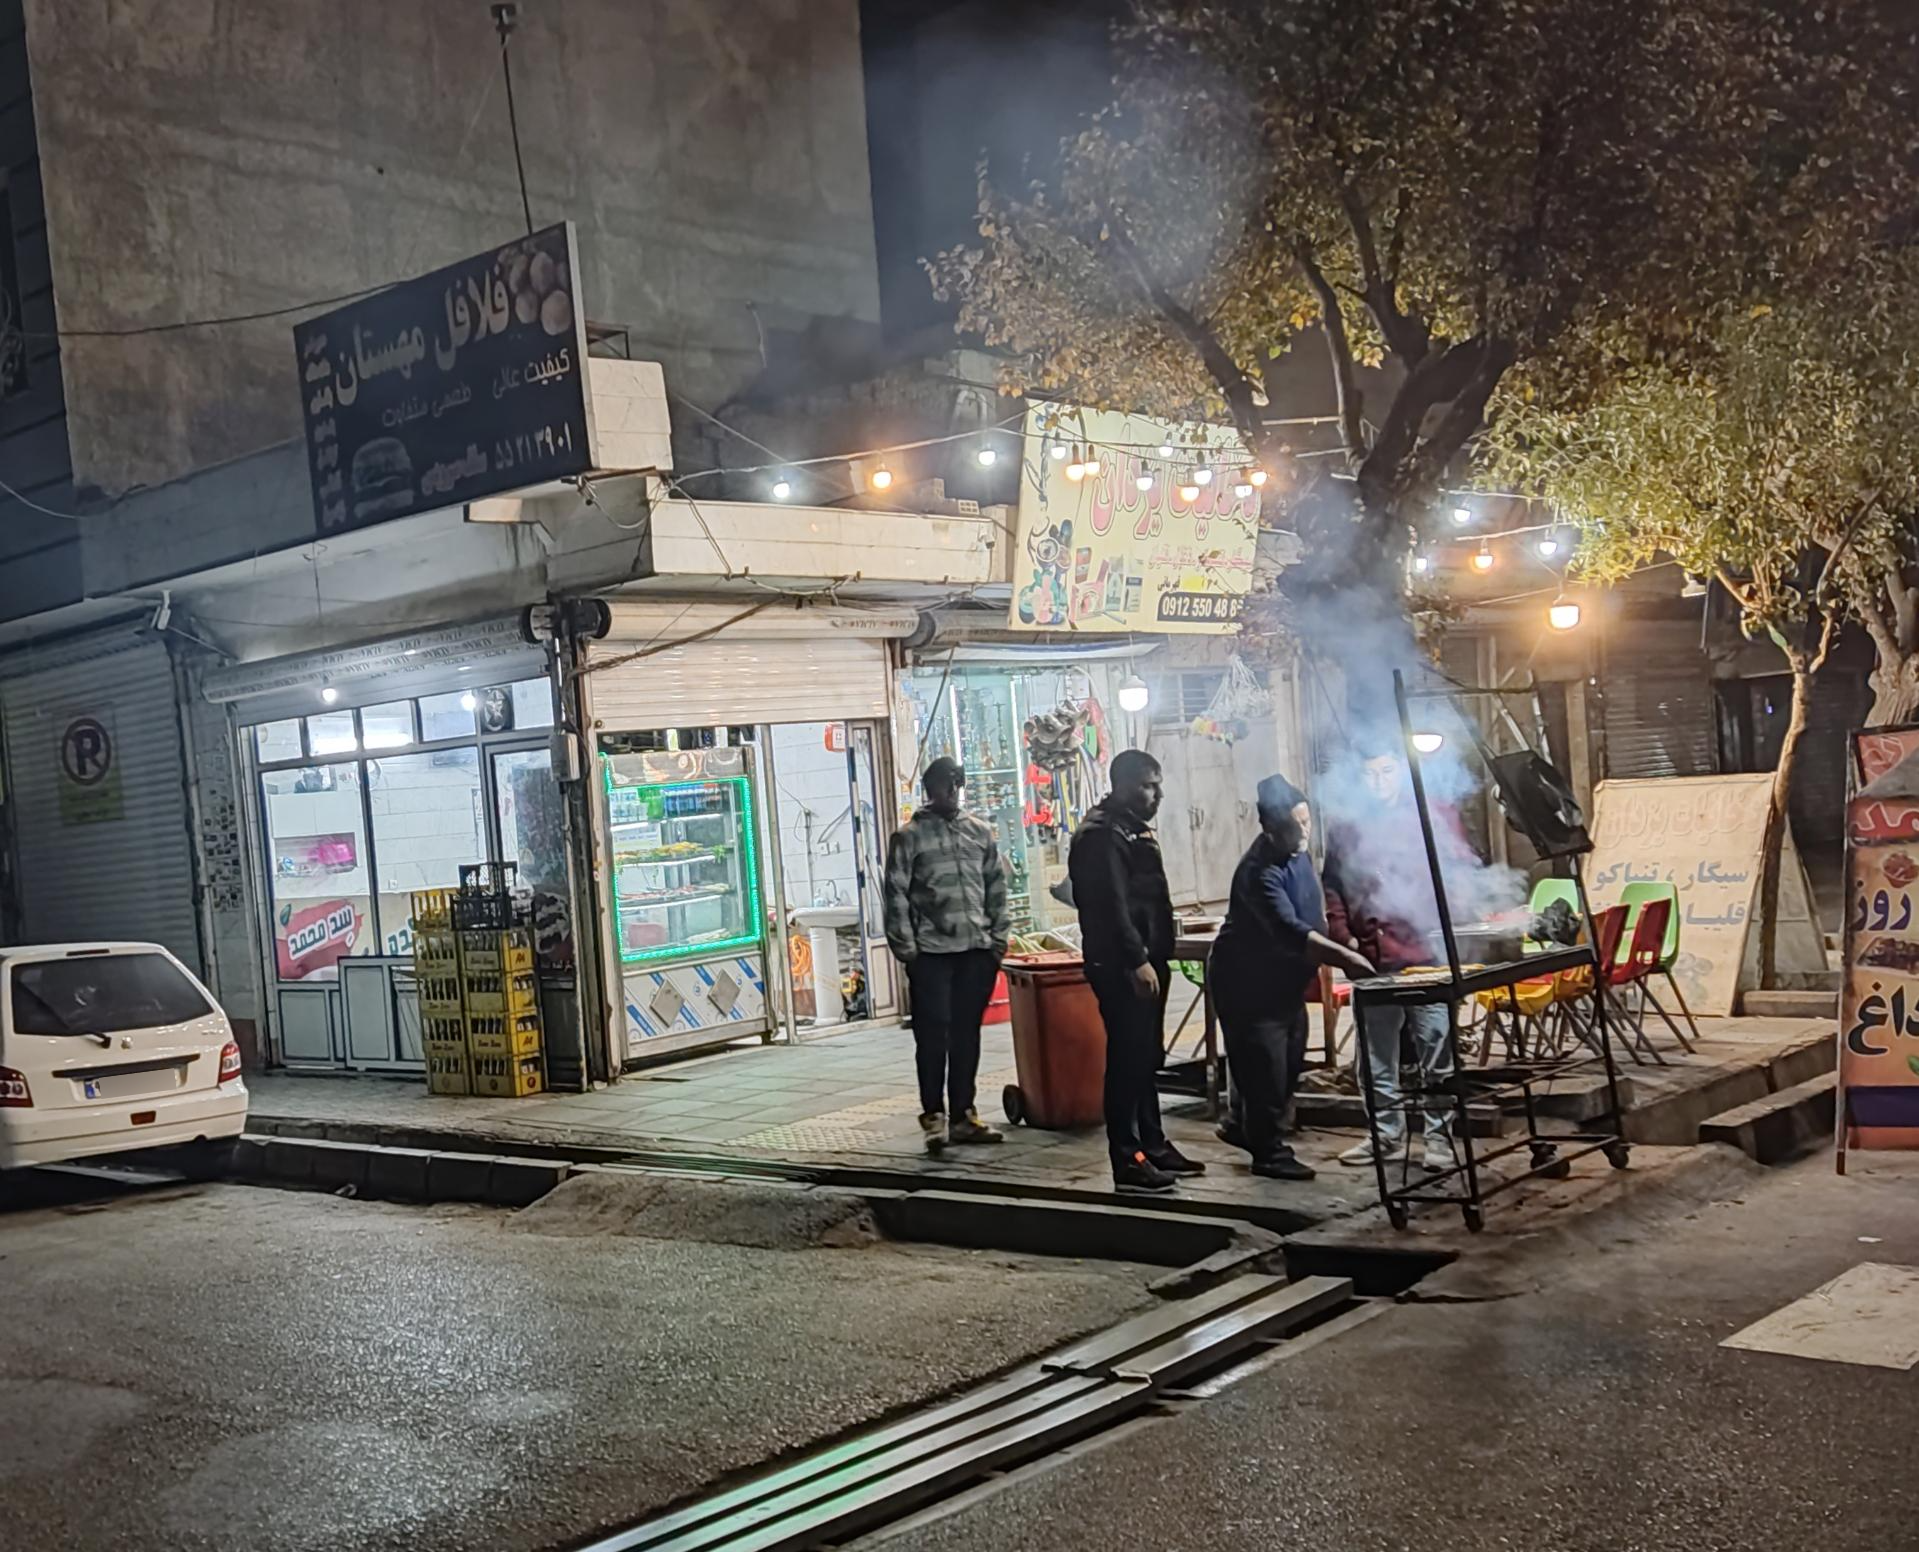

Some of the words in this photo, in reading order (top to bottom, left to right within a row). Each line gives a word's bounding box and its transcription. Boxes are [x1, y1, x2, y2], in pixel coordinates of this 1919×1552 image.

[436, 266, 510, 371] فلافل
[1162, 596, 1190, 616] 0912
[1191, 598, 1213, 617] 550
[1213, 599, 1229, 618] 48
[1681, 860, 1750, 890] سیگار
[1684, 902, 1747, 931] قلیا
[288, 919, 328, 959] محمد
